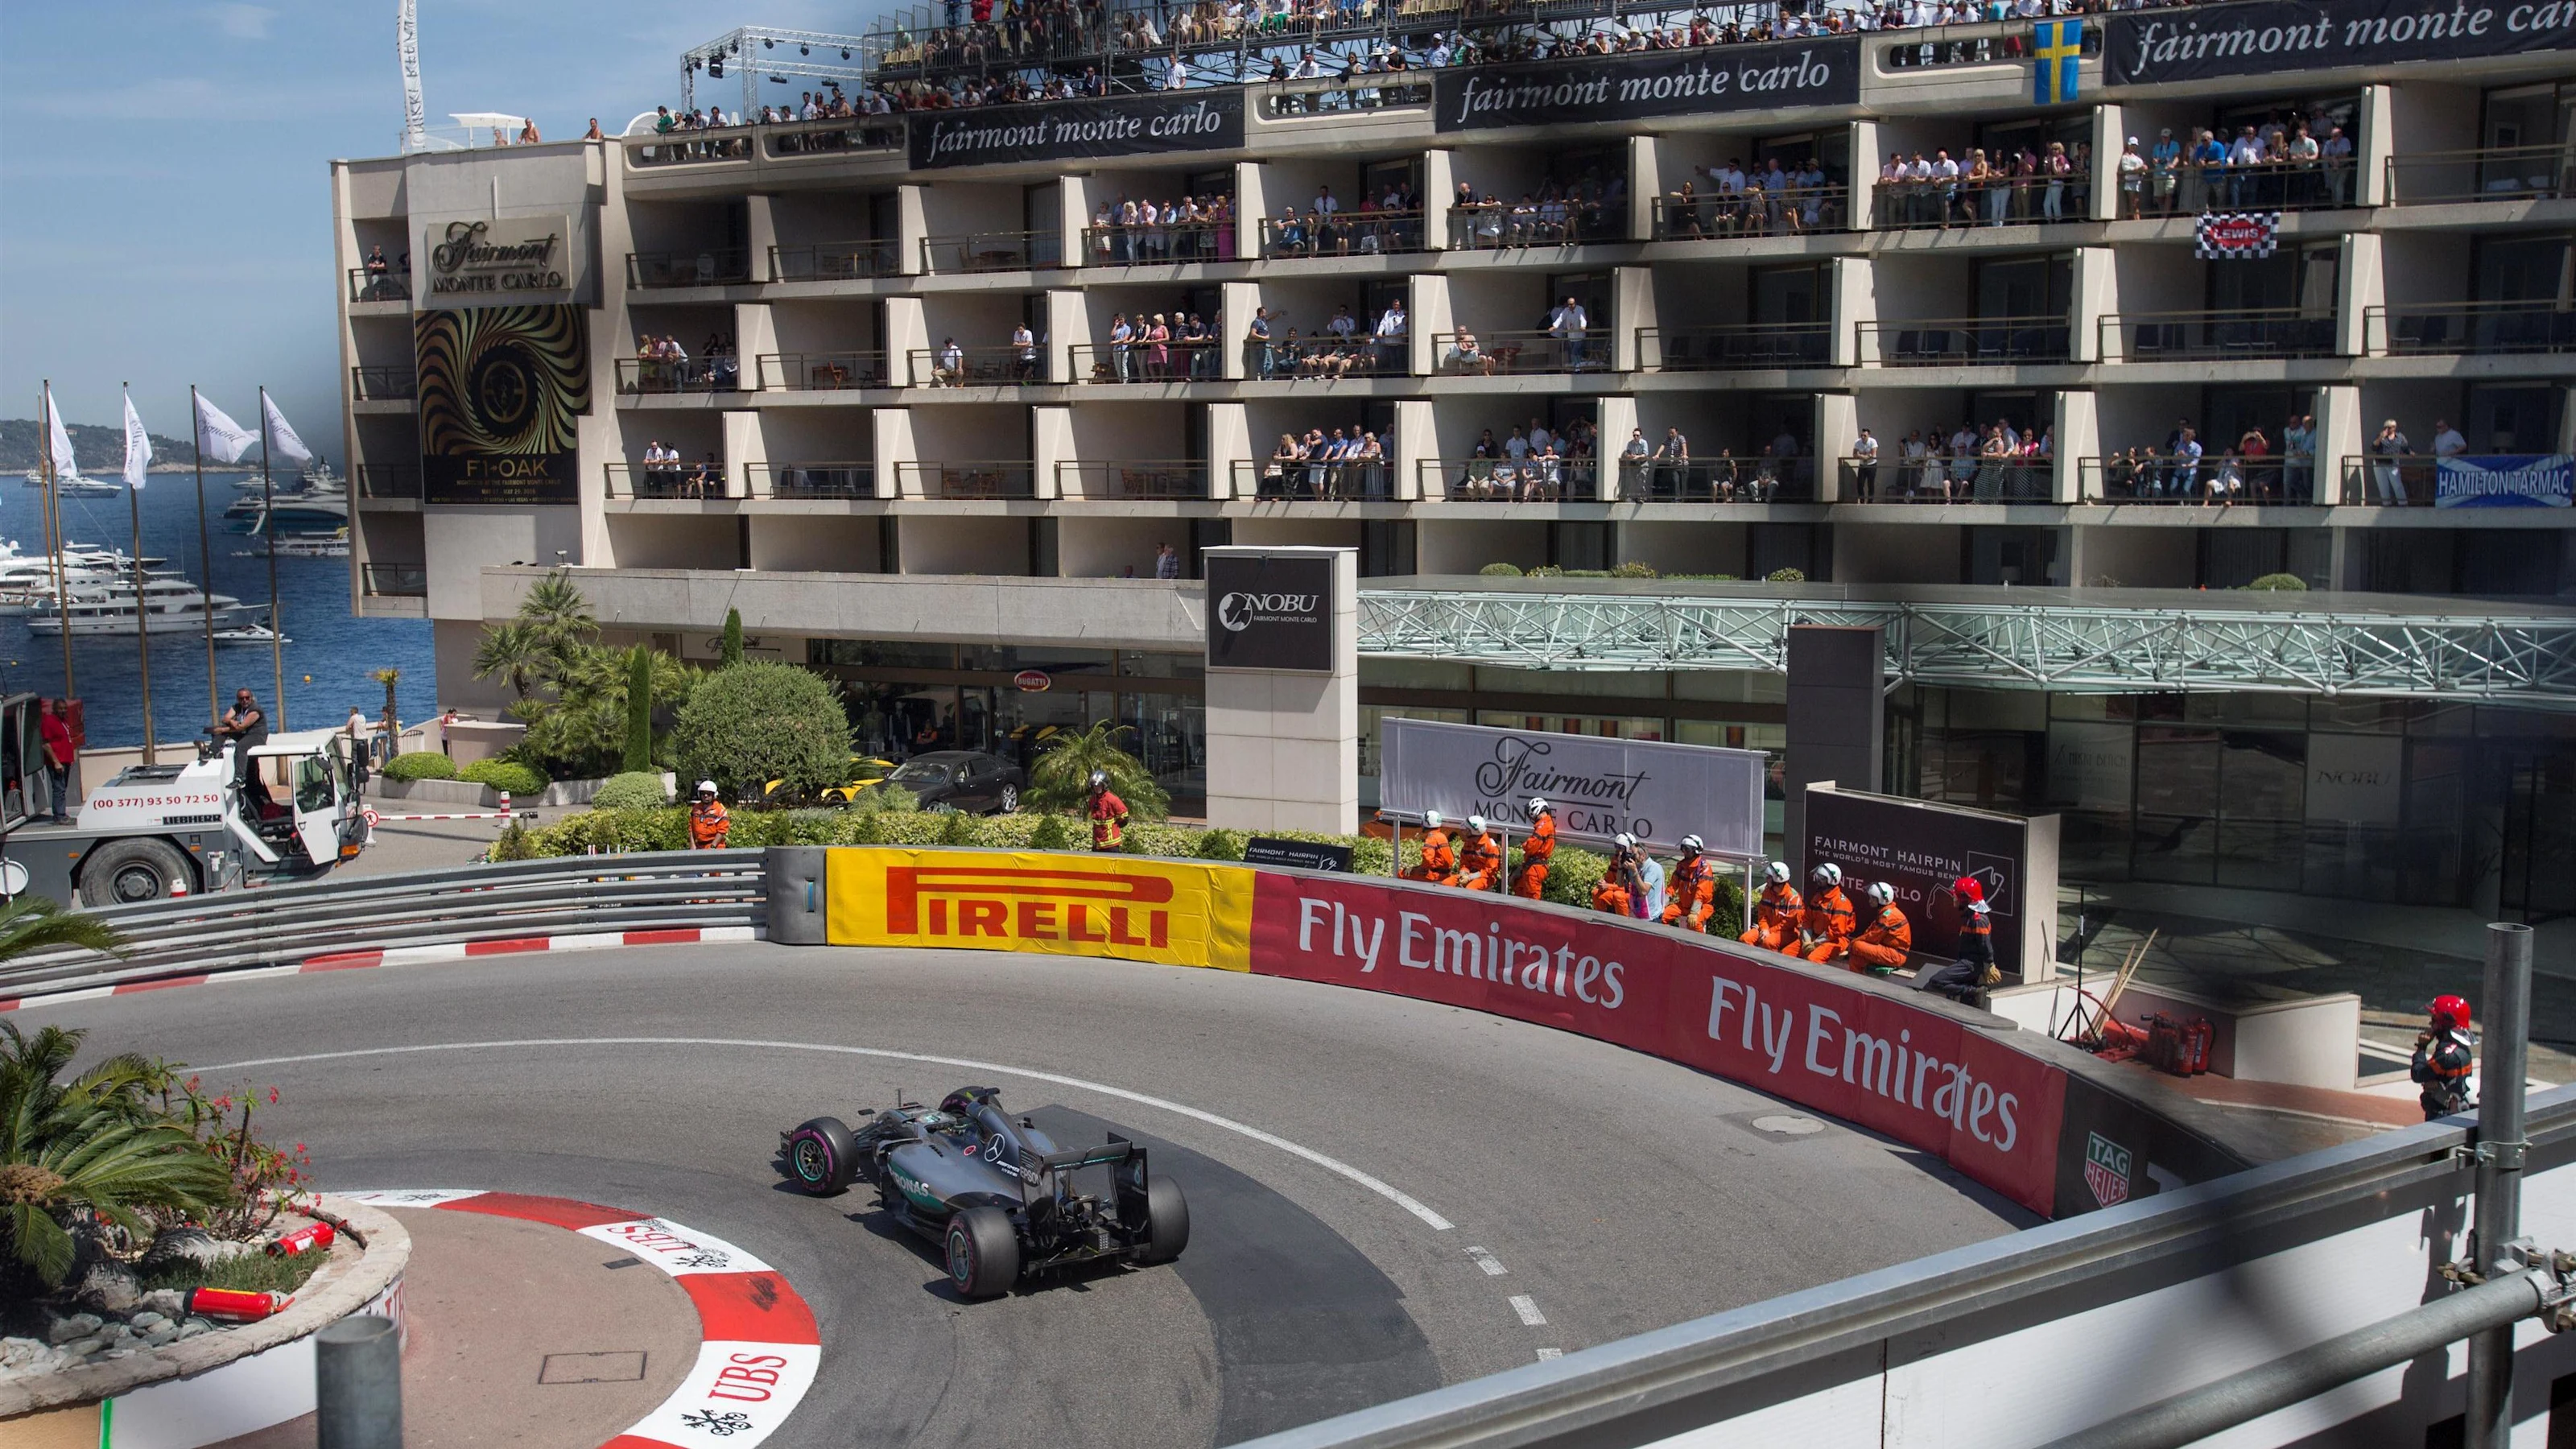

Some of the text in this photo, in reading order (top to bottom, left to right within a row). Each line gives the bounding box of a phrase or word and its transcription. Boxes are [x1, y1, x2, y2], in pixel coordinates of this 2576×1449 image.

[2131, 16, 2333, 76] fairmont
[2344, 6, 2494, 47] monte
[1457, 50, 1830, 123] fairmont monte carlo
[927, 100, 1221, 163] fairmont monte carlo
[432, 221, 560, 273] Fairmont
[2214, 228, 2259, 239] LEWIS
[433, 271, 563, 292] MONTE CARLO
[498, 458, 548, 477] OAK
[2438, 470, 2570, 496] HAMILTON TARMAC
[1243, 592, 1319, 612] NOBU
[1018, 677, 1046, 686] BUGATTI
[1476, 736, 1651, 811] Fairmont
[2315, 770, 2391, 786] NOBU
[93, 794, 218, 810] (00 377) 93 50 72 50
[163, 814, 222, 825] LIEBHERR
[1249, 847, 1319, 860] FAIRMONT HAIRPIN
[1814, 836, 1961, 872] FAIRMONT HAIRPIN
[1814, 849, 1961, 881] THE WORLD'S MOST FAMOUS BEND
[886, 866, 1174, 949] PIRELLI
[1298, 897, 1624, 1009] Fly Emirates
[1707, 976, 2019, 1152] Fly Emirates
[2092, 1137, 2128, 1174] TAG
[1020, 1166, 1042, 1186] EPSON
[2087, 1162, 2126, 1203] HEUER
[607, 1225, 697, 1253] UBS
[708, 1353, 787, 1402] UBS
